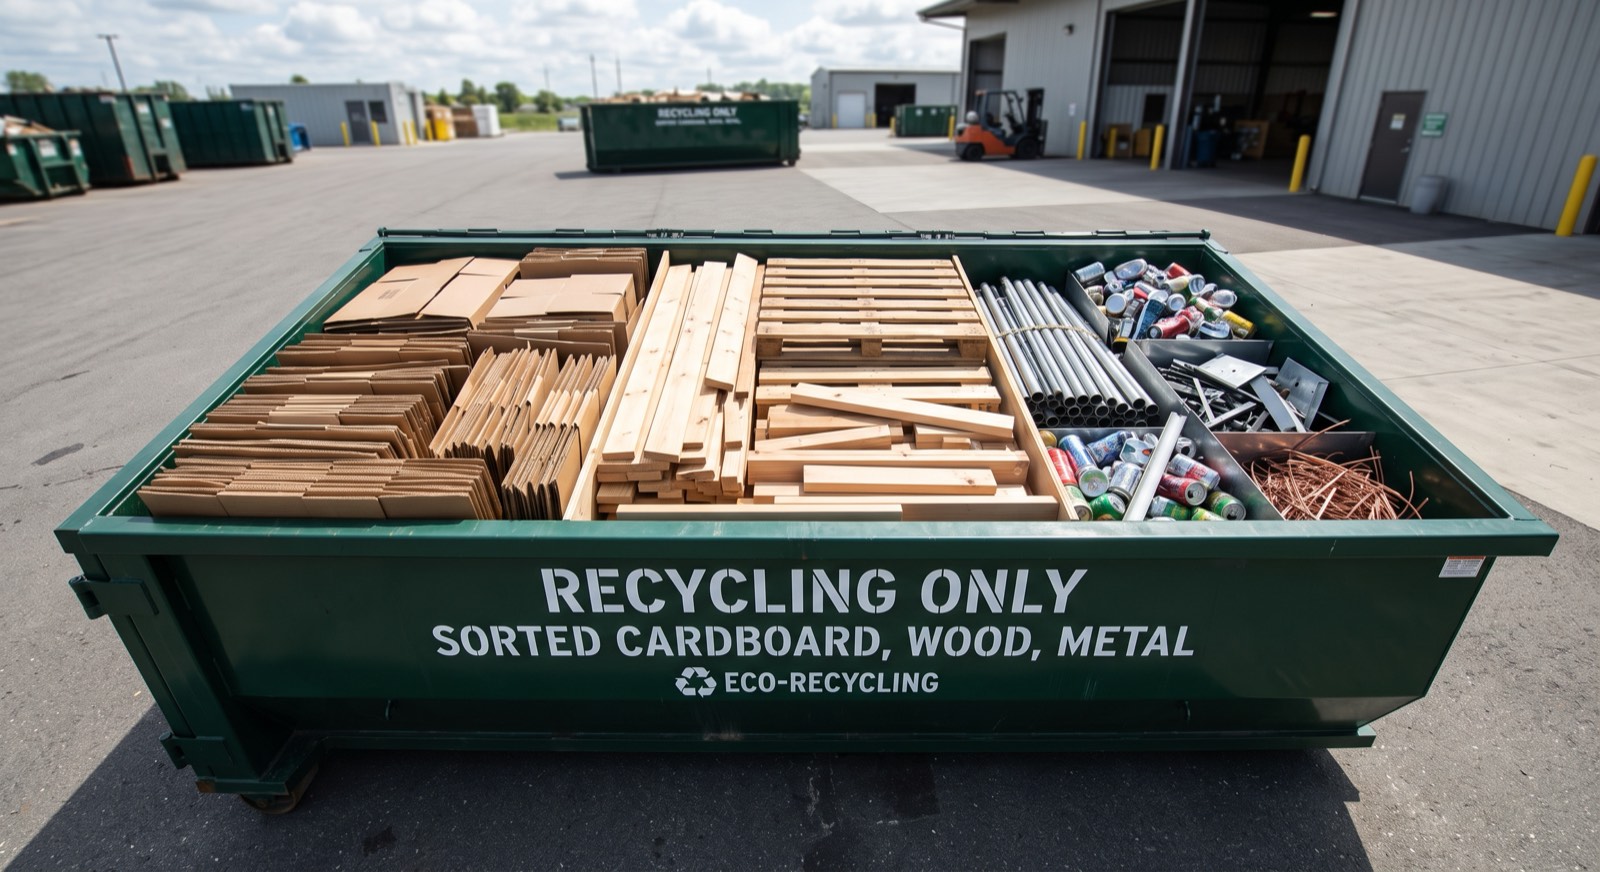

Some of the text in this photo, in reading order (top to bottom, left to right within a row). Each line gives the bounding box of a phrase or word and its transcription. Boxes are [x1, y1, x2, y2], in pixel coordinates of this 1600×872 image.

[657, 106, 737, 118] RECYCLING ONLY
[541, 569, 1088, 614] RECYCLING ONLY
[433, 625, 1194, 662] SORTED CARDBOARD, WOOD, METAL
[724, 672, 939, 693] ECO-RECYCLING
